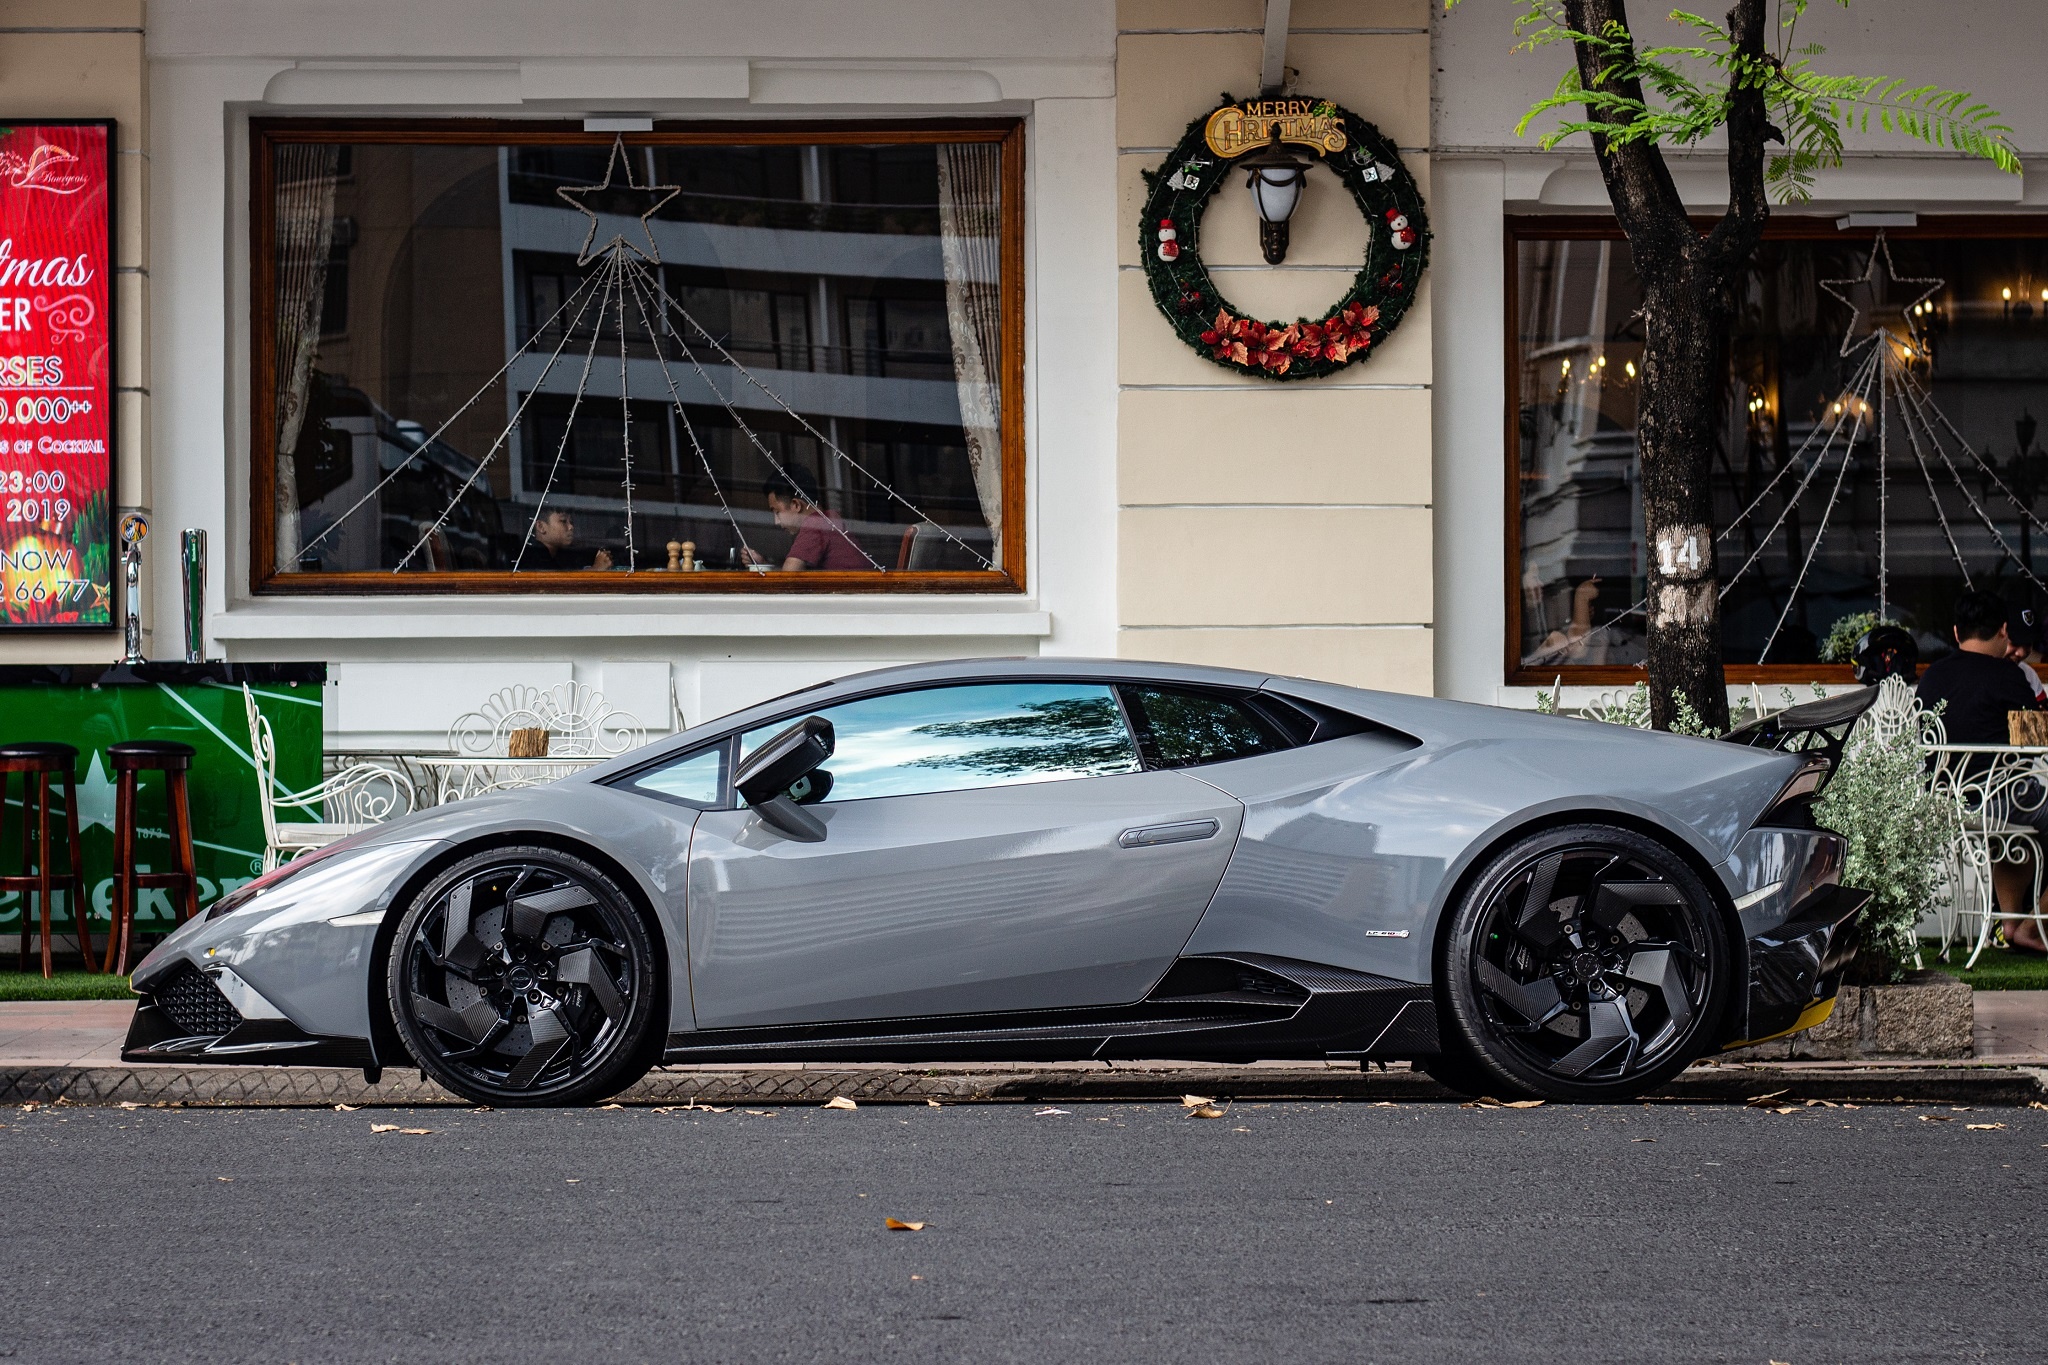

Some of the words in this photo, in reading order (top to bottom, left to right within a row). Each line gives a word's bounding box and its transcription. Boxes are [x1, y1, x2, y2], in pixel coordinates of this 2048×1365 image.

[1246, 100, 1313, 118] MERRY
[7, 499, 70, 522] 2019
[0, 549, 72, 572] NOW
[1658, 536, 1701, 575] 14
[15, 579, 46, 602] 66
[56, 579, 90, 602] 77
